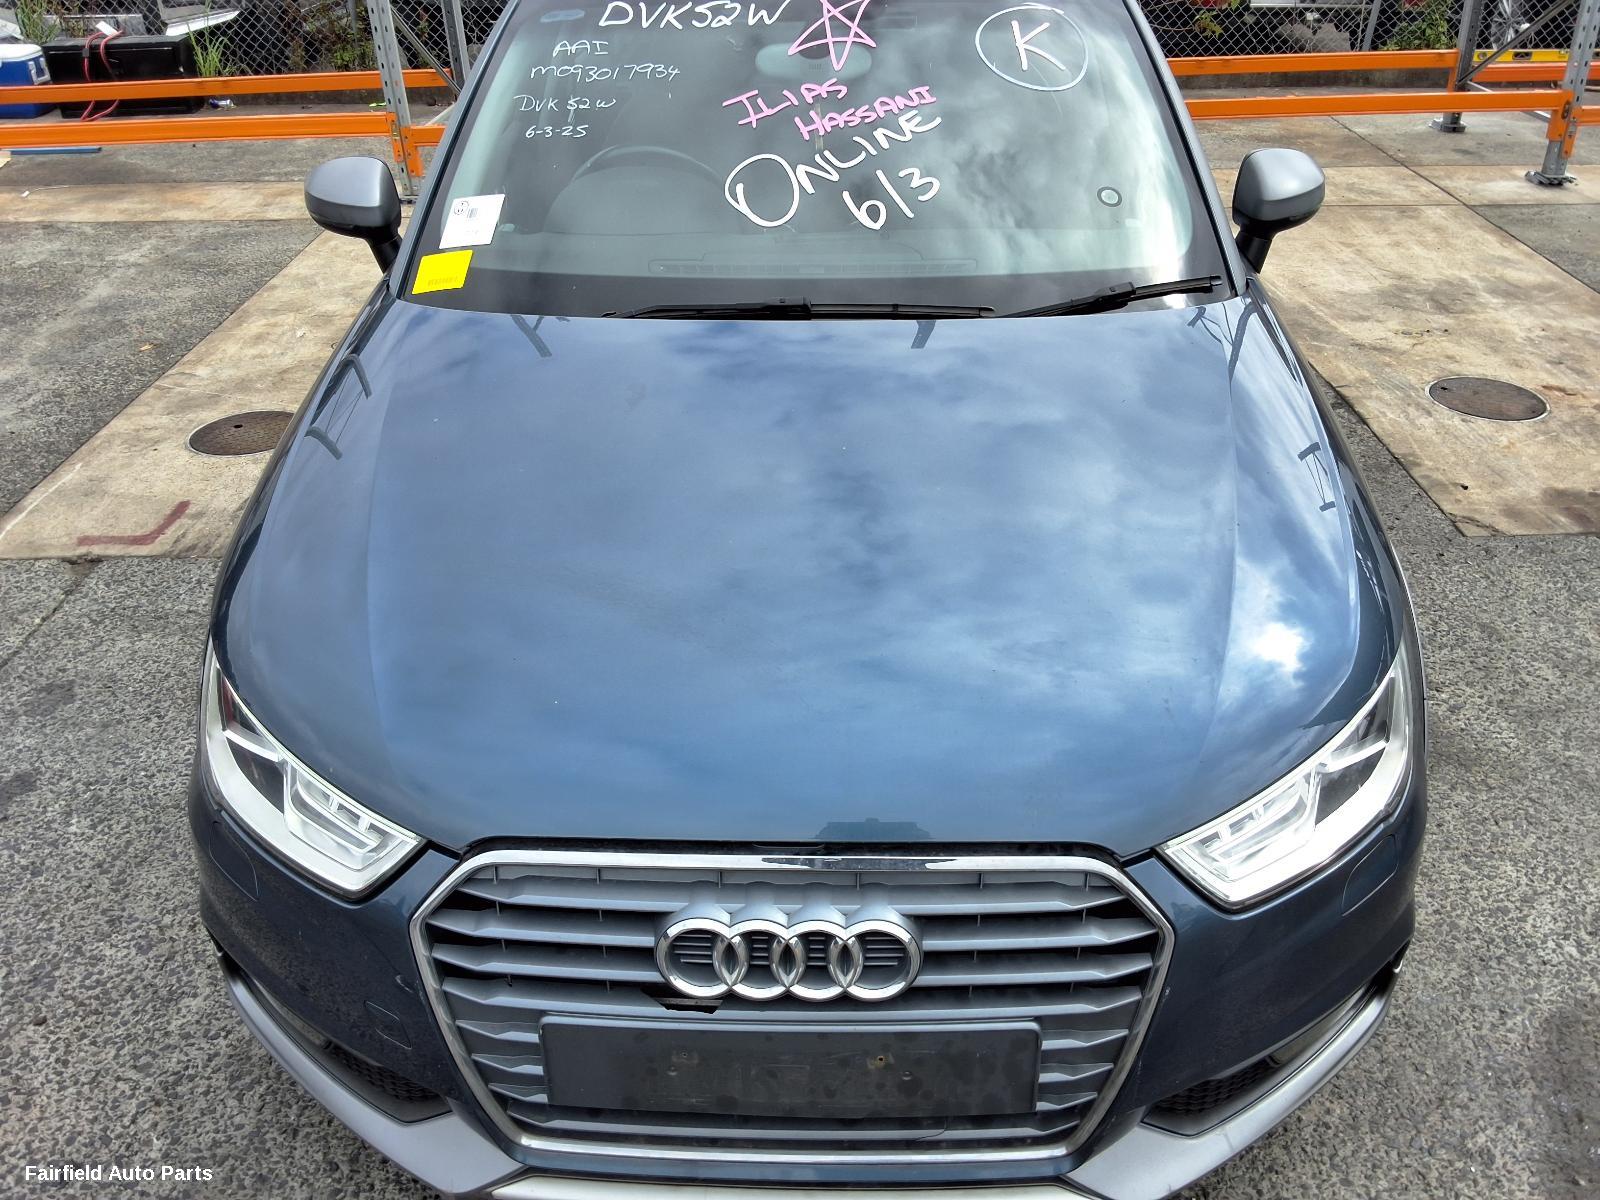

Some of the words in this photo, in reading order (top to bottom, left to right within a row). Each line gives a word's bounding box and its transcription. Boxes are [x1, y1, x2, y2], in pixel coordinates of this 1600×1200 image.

[1010, 20, 1067, 72] K
[513, 94, 559, 112] DVK
[794, 85, 937, 140] HASSANI
[525, 124, 589, 138] 6-3-25
